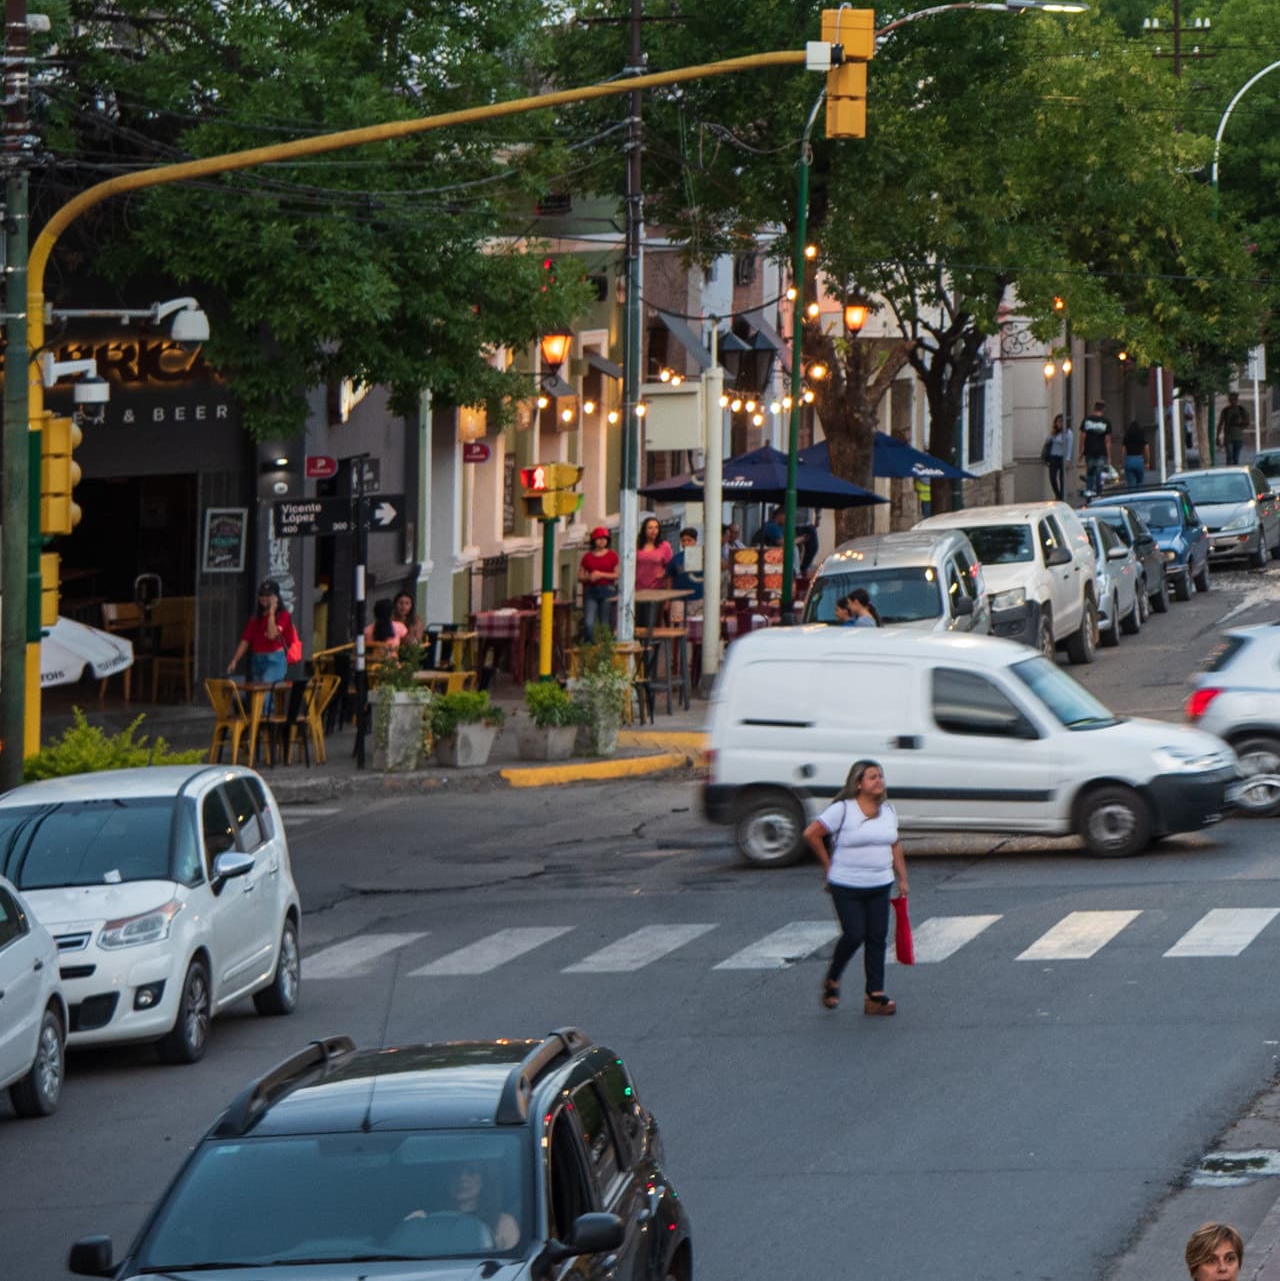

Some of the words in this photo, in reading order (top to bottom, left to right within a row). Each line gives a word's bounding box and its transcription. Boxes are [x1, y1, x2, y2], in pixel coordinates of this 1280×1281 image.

[153, 405, 229, 423] BEER
[281, 503, 322, 514] Vicente
[282, 513, 316, 524] López
